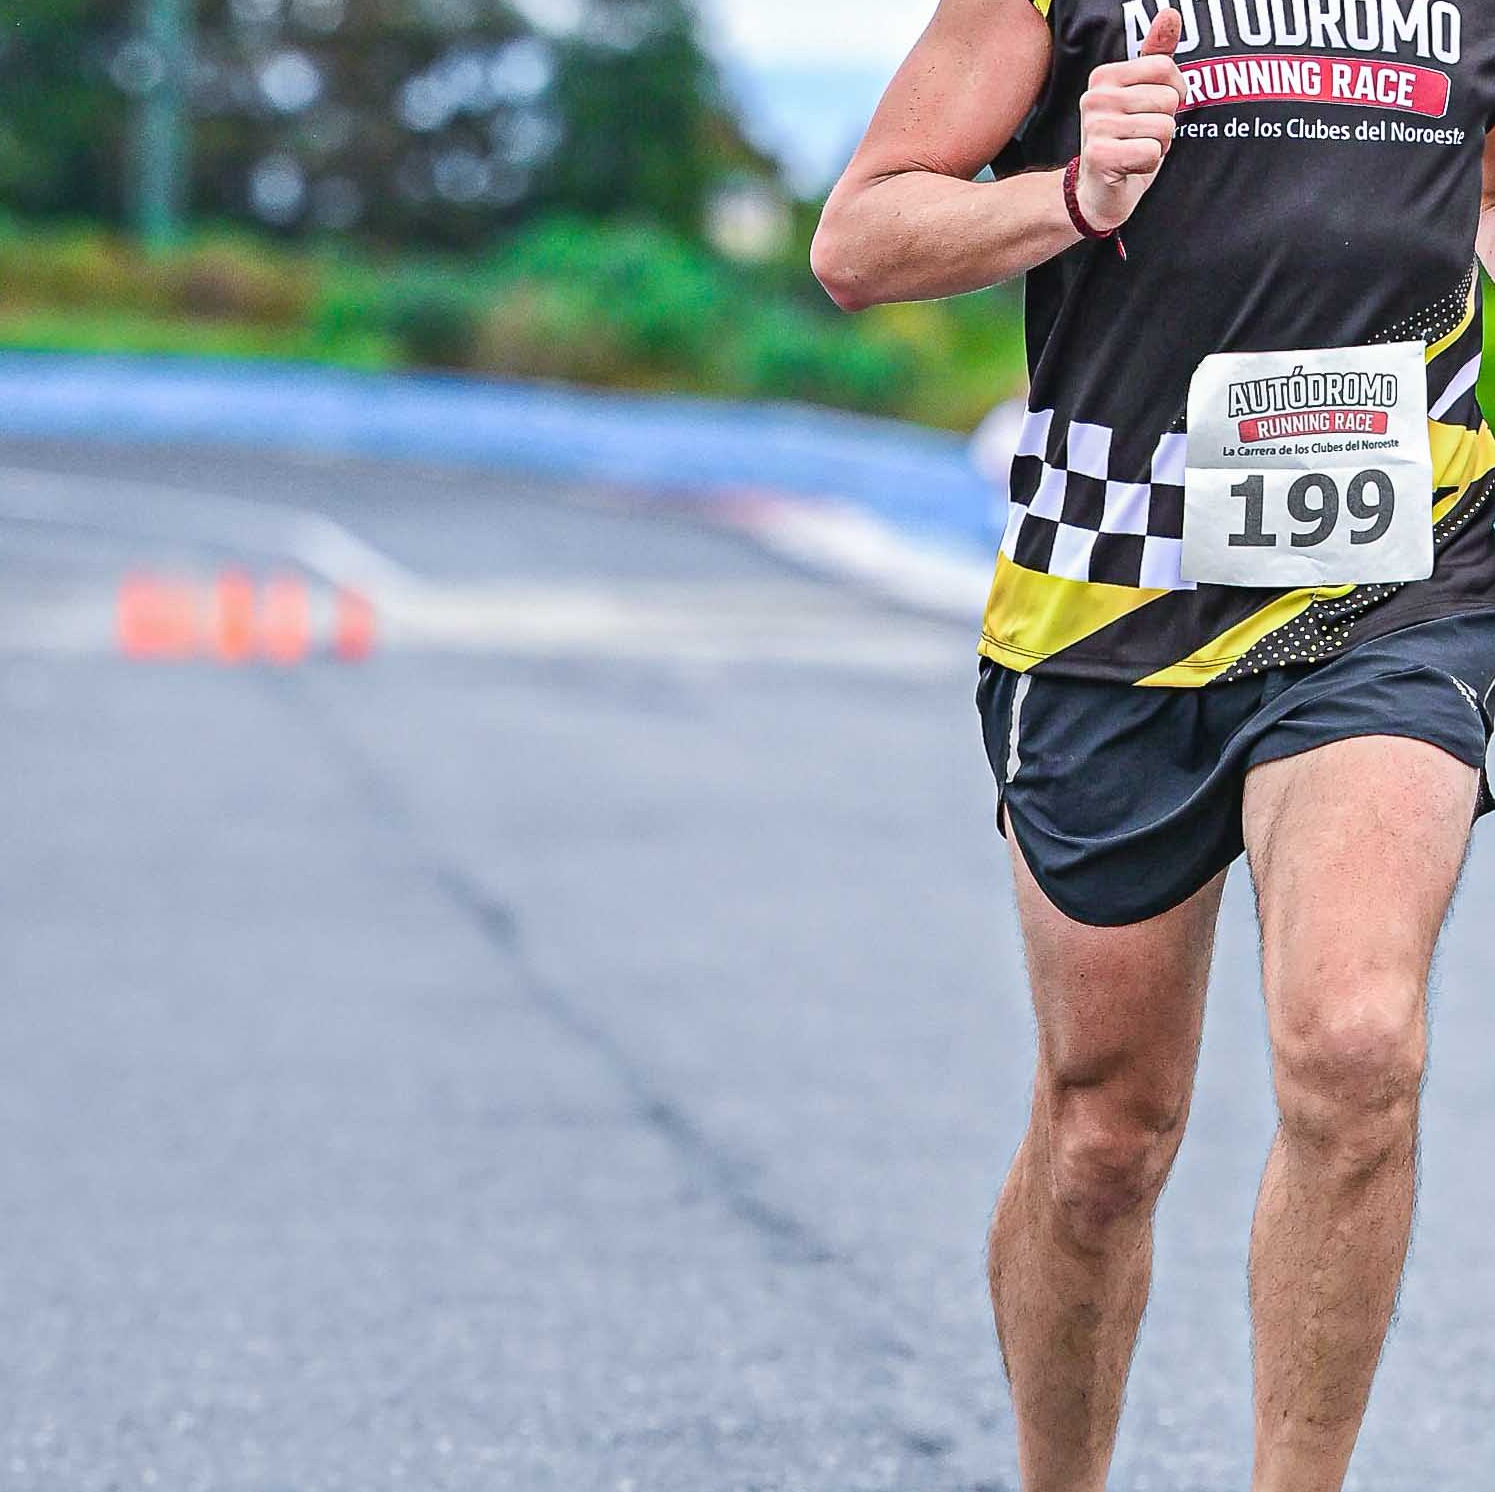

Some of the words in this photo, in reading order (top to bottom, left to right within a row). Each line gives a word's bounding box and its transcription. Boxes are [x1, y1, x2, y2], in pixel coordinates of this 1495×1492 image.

[1184, 59, 1322, 106] RUNNING
[1331, 63, 1416, 108] RACE
[1224, 117, 1249, 138] de
[1254, 117, 1282, 138] los
[1286, 118, 1351, 141] Clubes
[1355, 120, 1386, 141] del
[1390, 122, 1465, 145] Noroeste
[1228, 365, 1397, 417] AUTÓDROMO
[1257, 413, 1330, 439] RUNNING
[1334, 413, 1374, 432] RACE
[1223, 446, 1235, 456] La
[1237, 446, 1276, 456] Carrera
[1278, 445, 1293, 455] de
[1295, 443, 1310, 455] los
[1311, 442, 1343, 454] Clubes
[1345, 440, 1360, 452] del
[1361, 438, 1399, 450] Noroeste
[1228, 469, 1395, 547] 199
